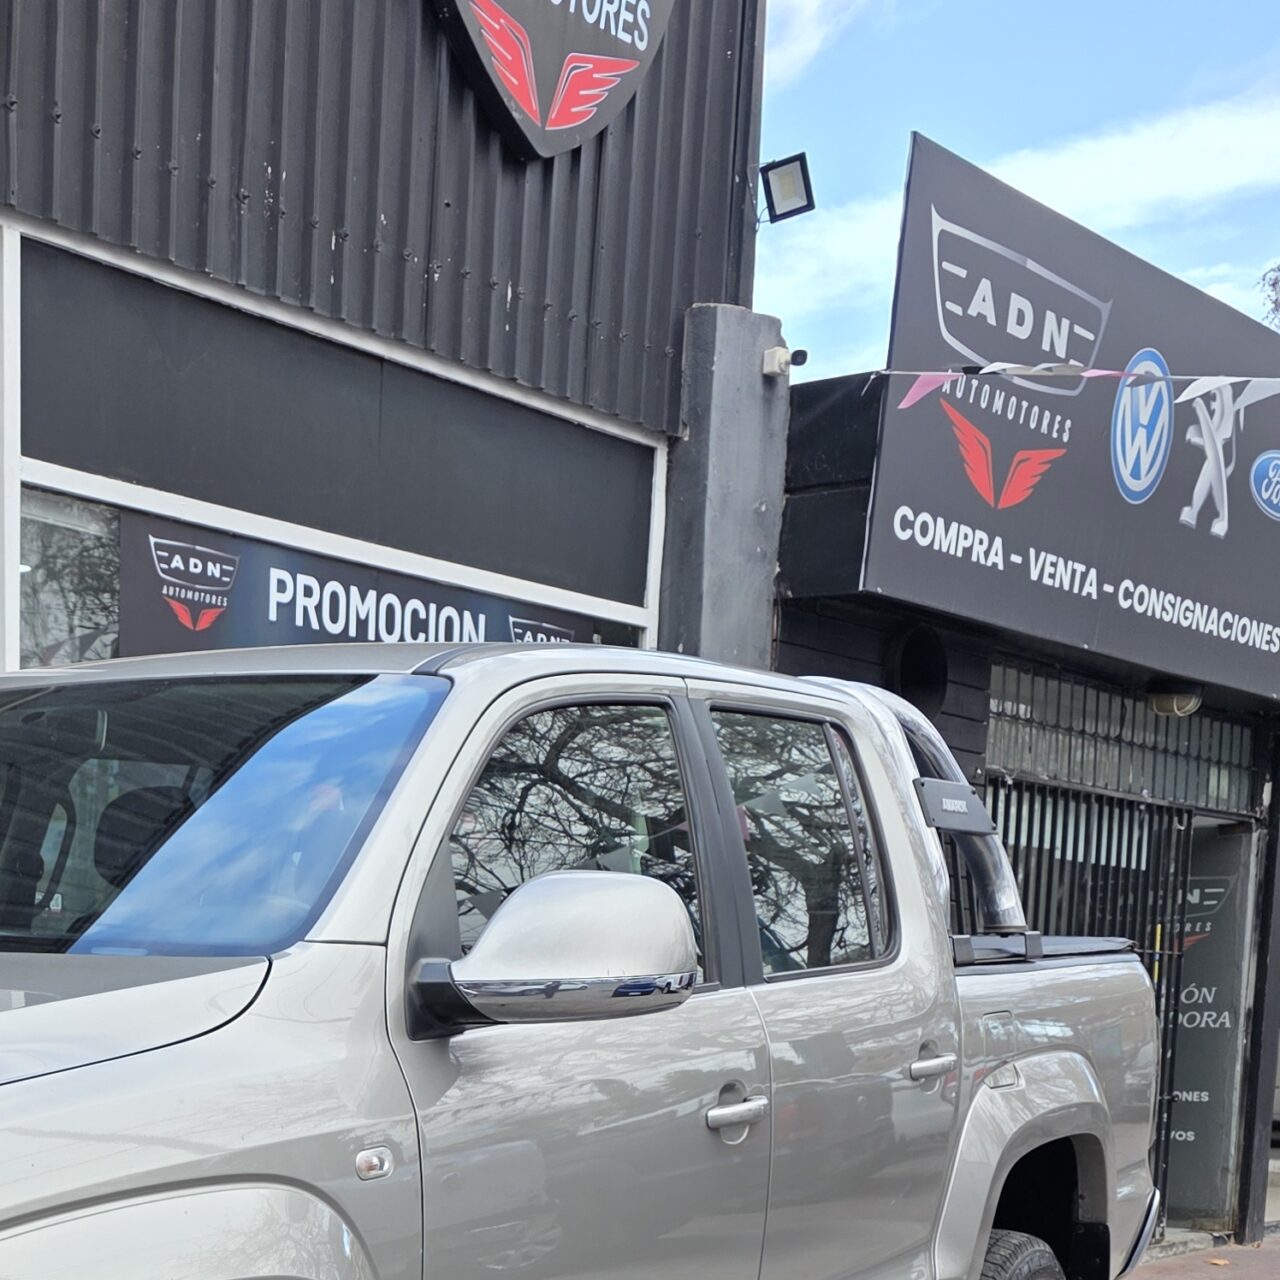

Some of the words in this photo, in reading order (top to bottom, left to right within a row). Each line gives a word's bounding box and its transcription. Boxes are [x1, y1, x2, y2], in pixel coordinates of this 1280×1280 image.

[967, 278, 1070, 359] ADN
[942, 370, 1072, 442] AUTOMOTORES
[161, 584, 228, 607] AUTOMOTORES
[170, 554, 221, 578] ADN
[893, 505, 1005, 571] COMPRA
[1029, 547, 1098, 600] VENTA
[1118, 579, 1280, 653] CONSIGNACIONES
[268, 567, 486, 643] PROMOCION
